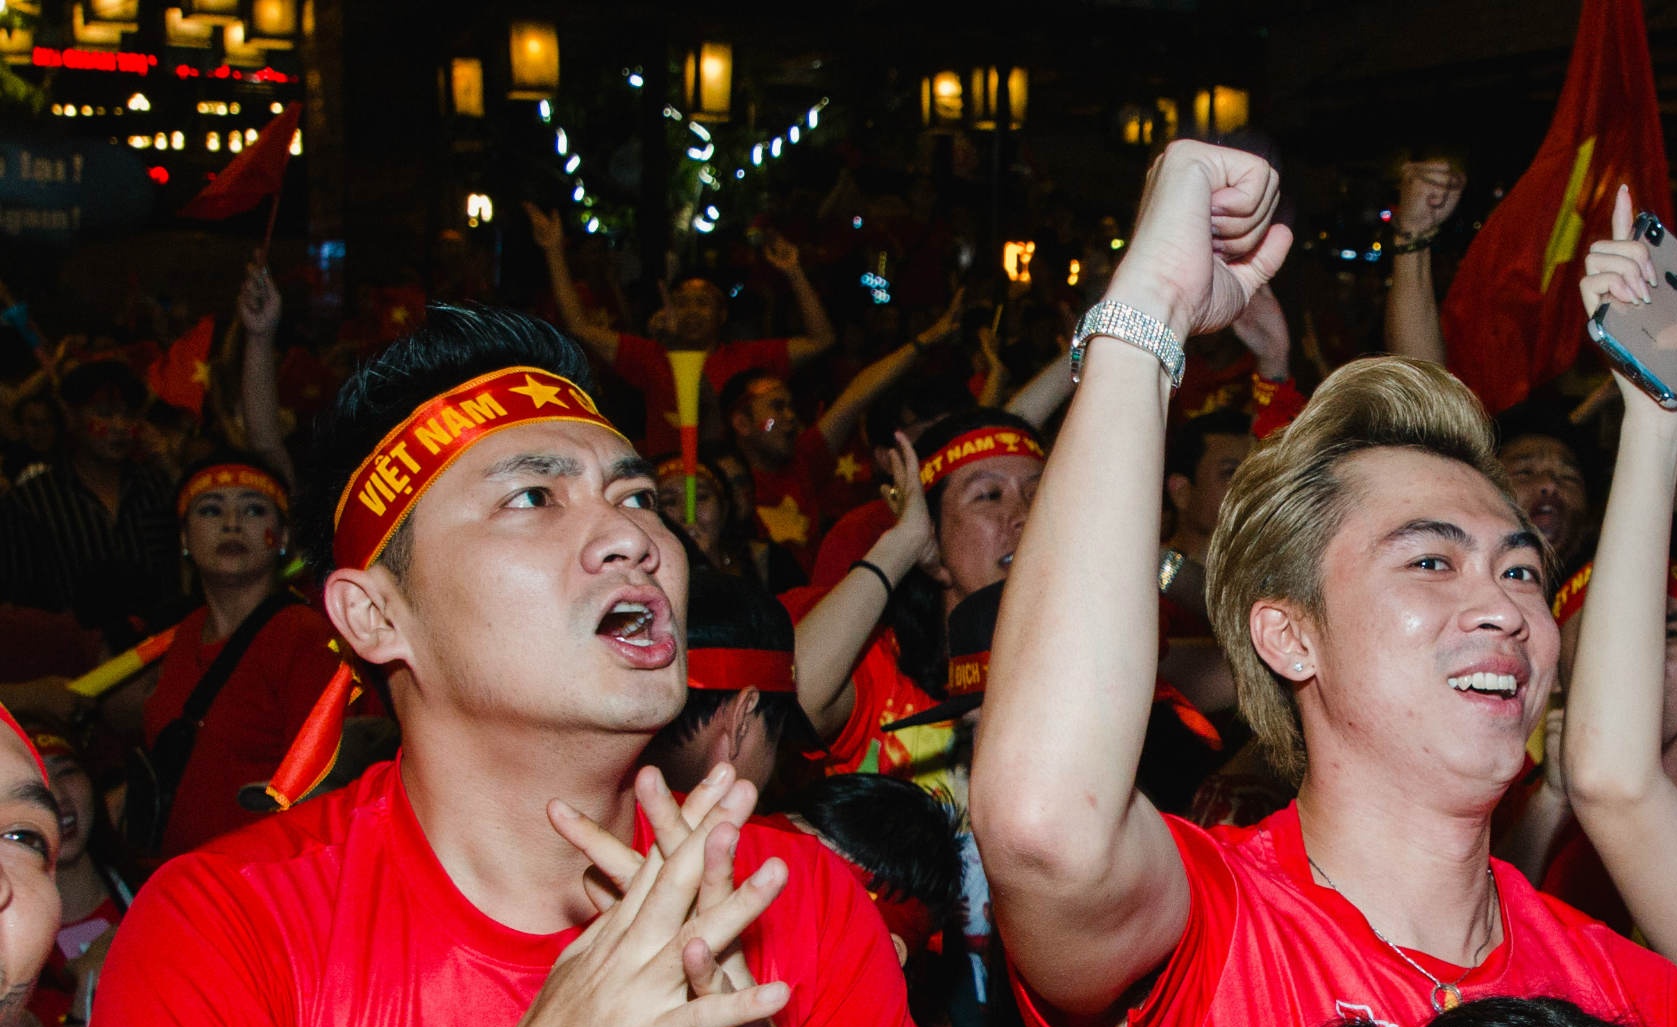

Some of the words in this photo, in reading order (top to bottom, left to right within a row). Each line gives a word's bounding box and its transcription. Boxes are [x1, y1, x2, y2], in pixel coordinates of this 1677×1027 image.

[358, 440, 422, 518] VIỆT
[412, 391, 508, 456] NAM
[946, 435, 996, 464] NAM
